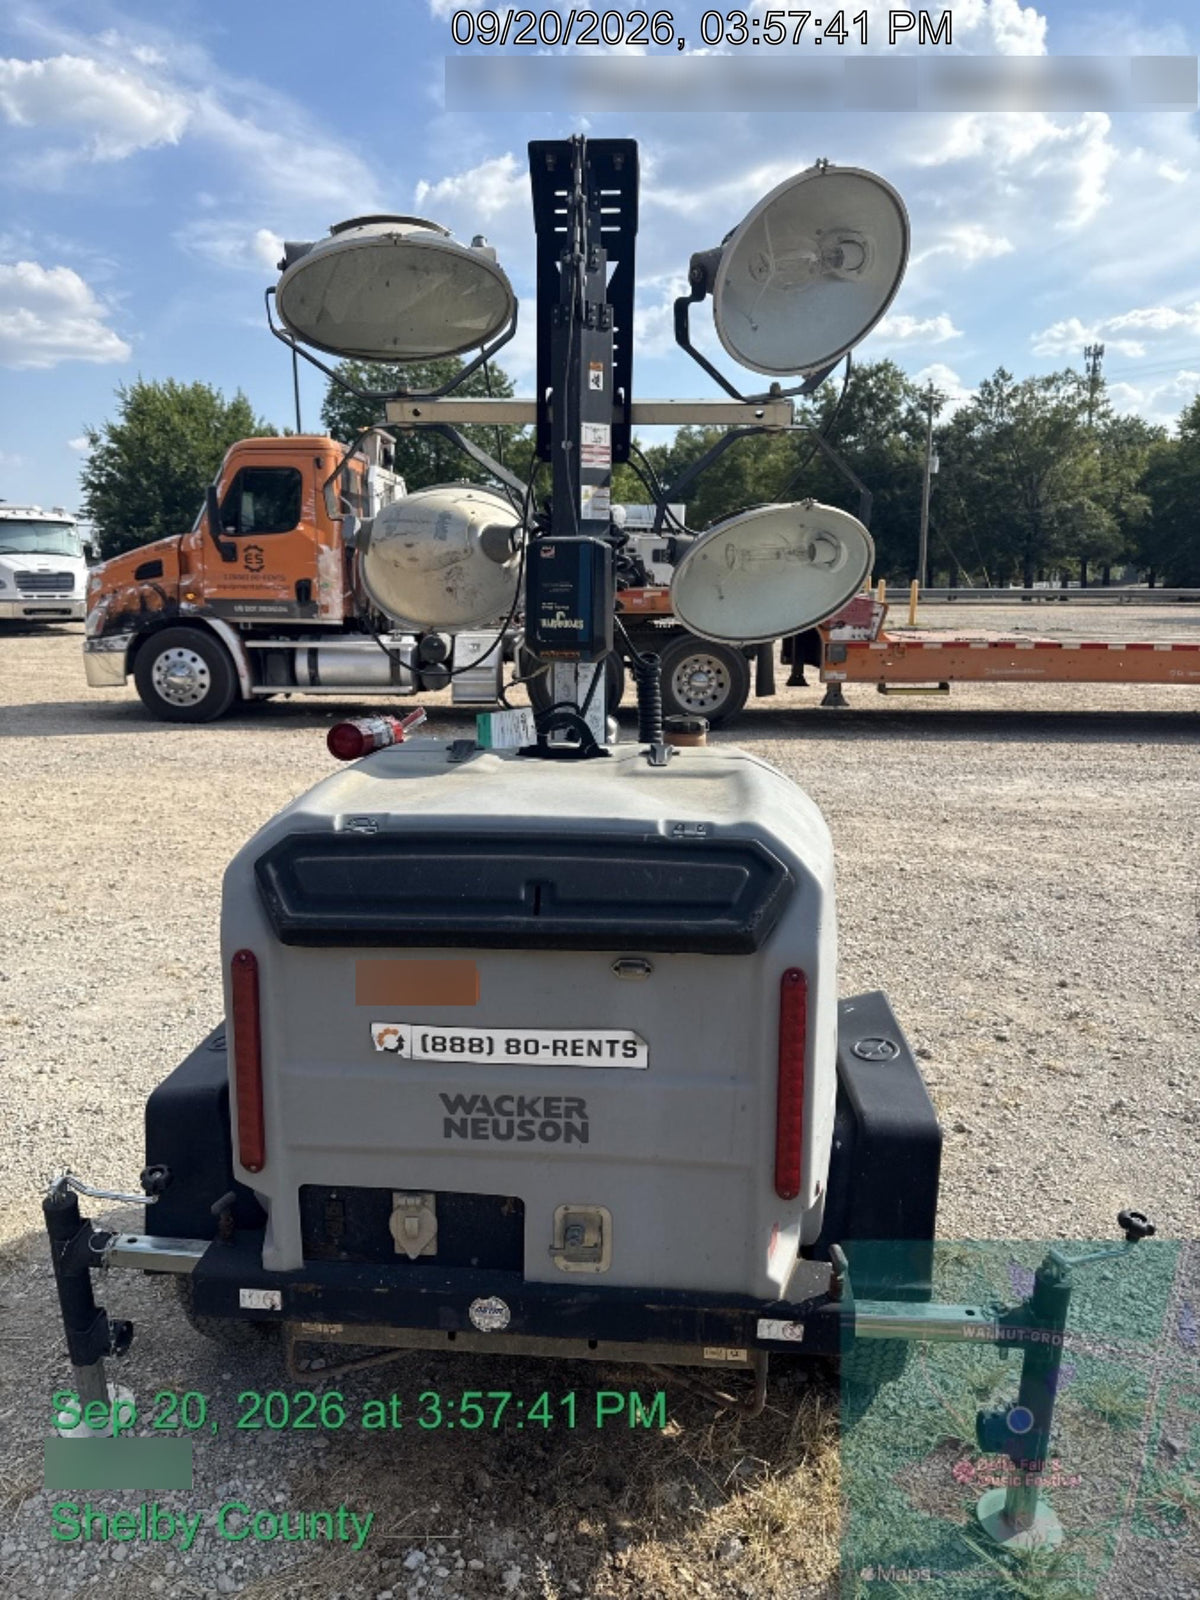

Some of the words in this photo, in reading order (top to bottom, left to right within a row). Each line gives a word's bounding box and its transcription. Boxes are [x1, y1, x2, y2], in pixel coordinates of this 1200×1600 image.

[421, 1033, 495, 1056] (888)
[504, 1036, 638, 1059] 80-RENTS
[438, 1092, 590, 1120] WACKER
[443, 1117, 590, 1144] NEUSON
